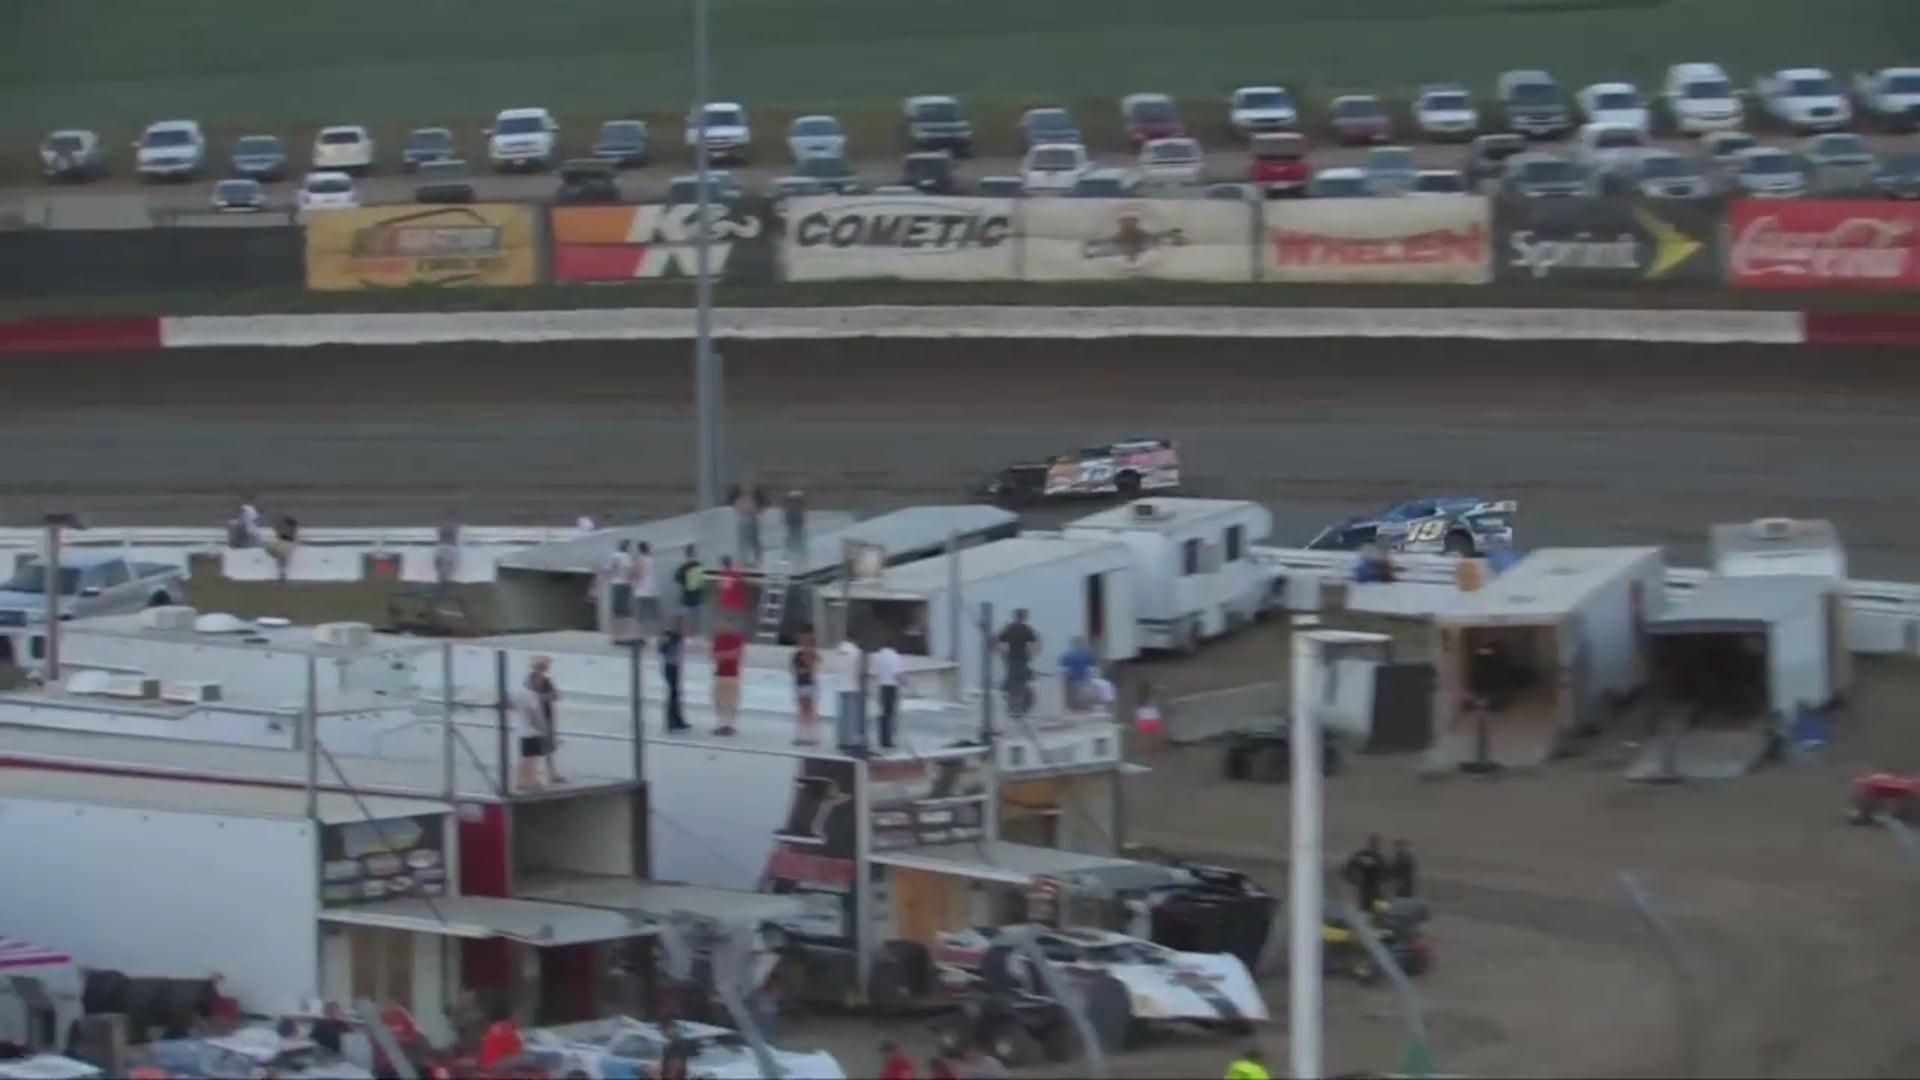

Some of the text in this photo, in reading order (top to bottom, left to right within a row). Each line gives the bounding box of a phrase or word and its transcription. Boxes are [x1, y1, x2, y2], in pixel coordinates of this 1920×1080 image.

[799, 212, 1009, 249] COMETIC
[1732, 215, 1914, 279] Coca-Cola
[1509, 230, 1640, 278] Sprint
[1407, 519, 1447, 542] 19
